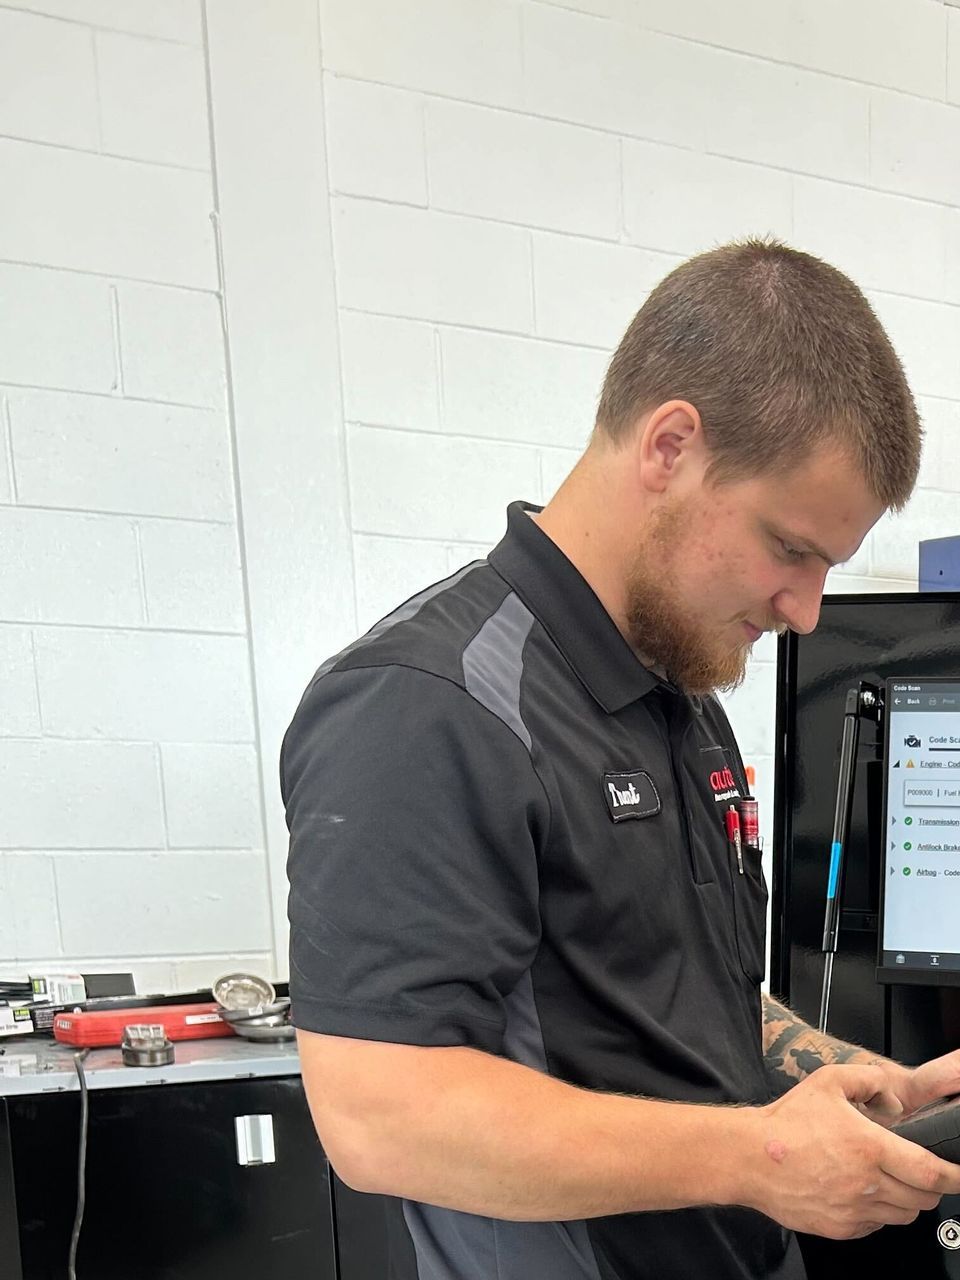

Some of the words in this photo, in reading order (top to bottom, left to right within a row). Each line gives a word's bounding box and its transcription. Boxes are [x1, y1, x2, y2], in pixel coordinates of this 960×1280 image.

[929, 736, 948, 744] Code
[920, 761, 942, 769] Engine
[917, 869, 937, 877] Airbag
